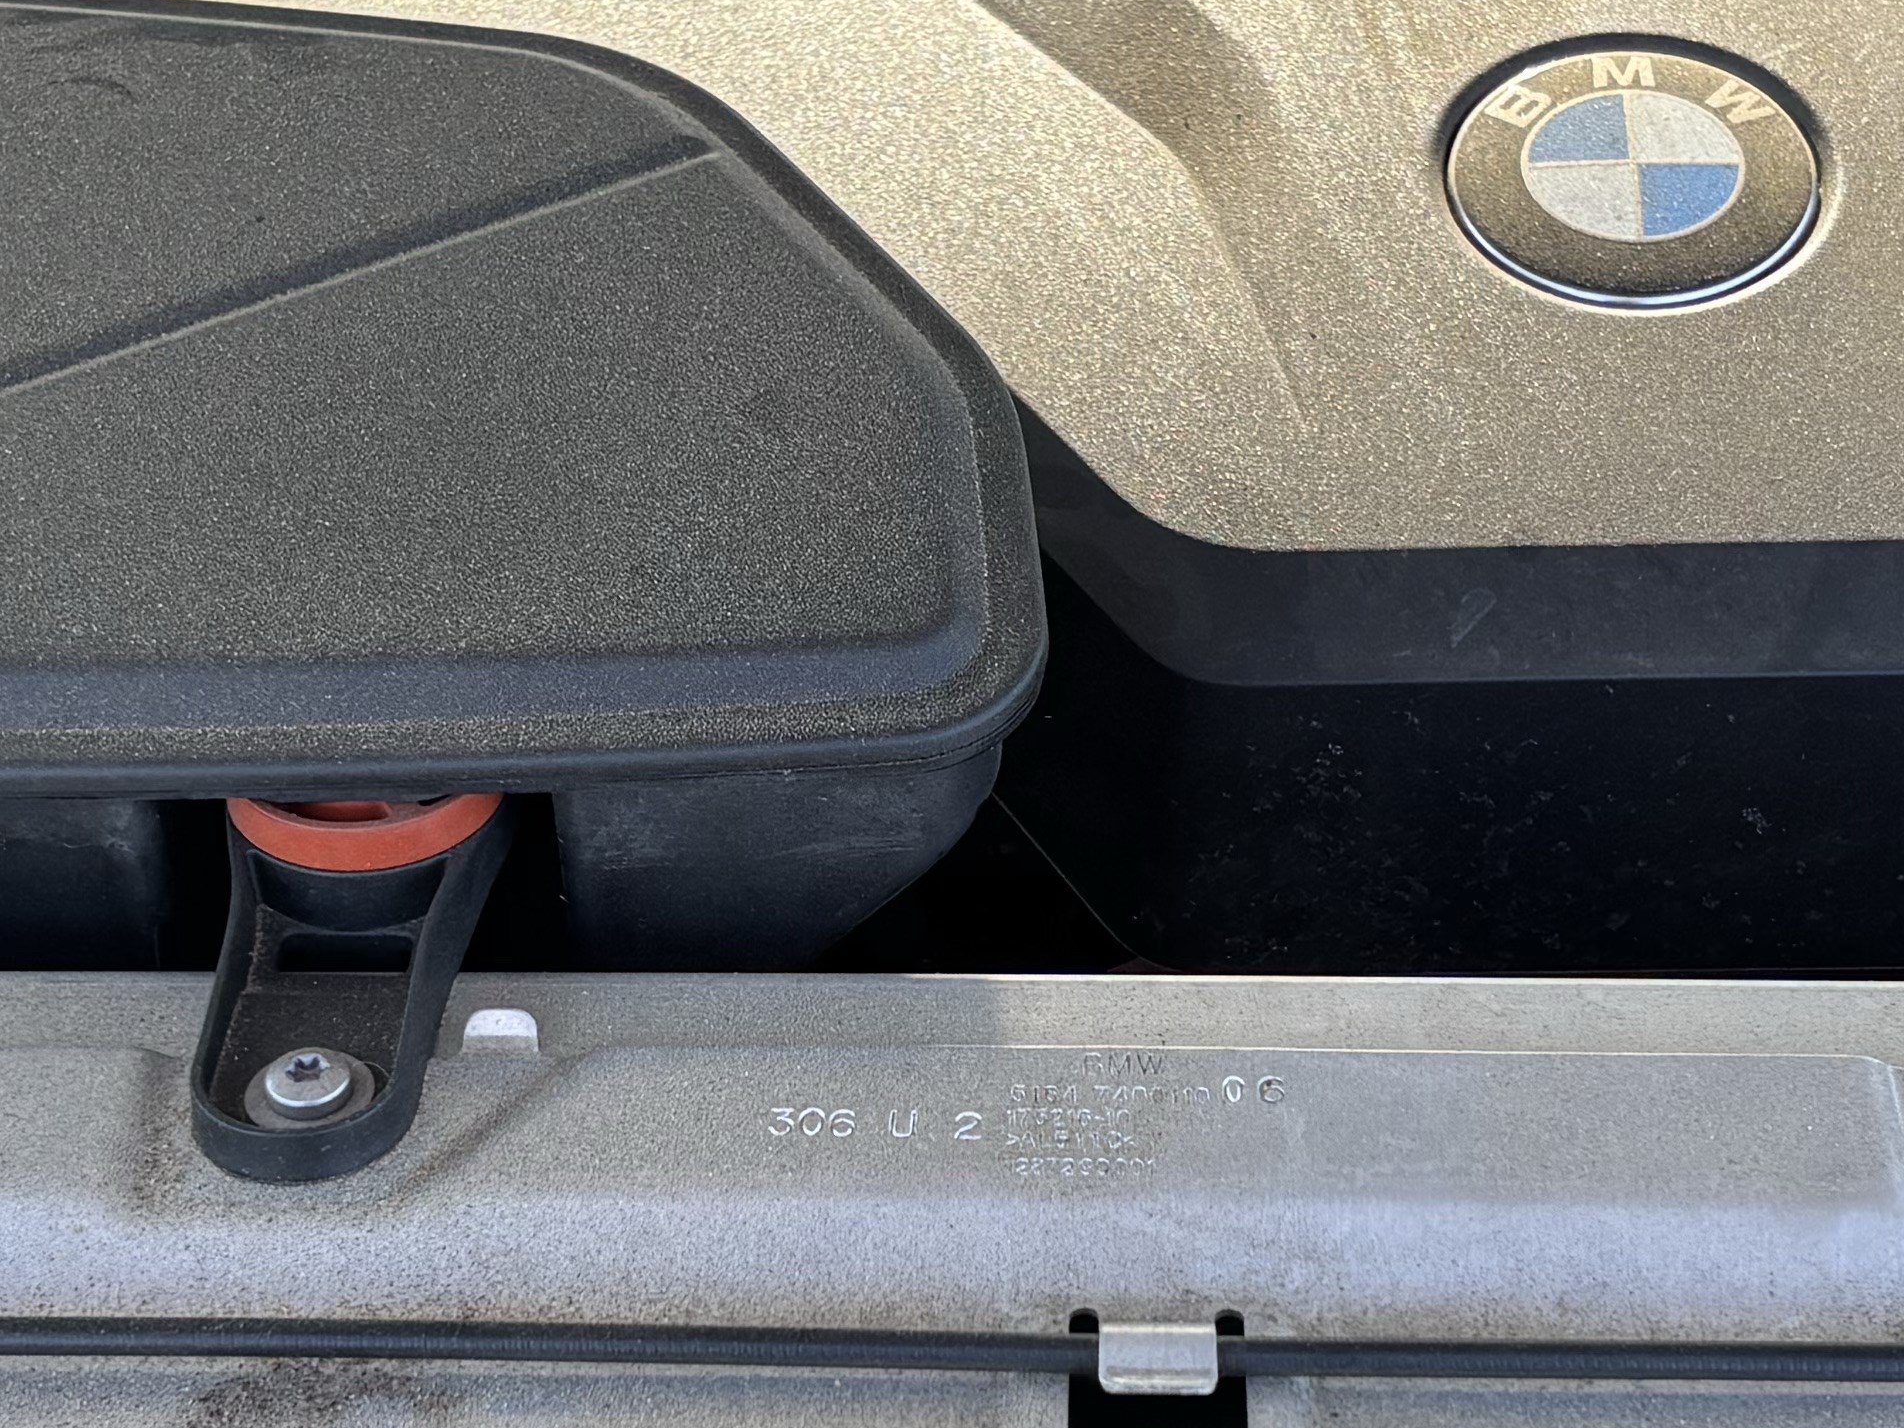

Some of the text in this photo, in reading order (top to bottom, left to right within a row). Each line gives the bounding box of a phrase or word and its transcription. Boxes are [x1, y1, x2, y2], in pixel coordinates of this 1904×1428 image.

[1484, 56, 1776, 128] BMW
[767, 1107, 984, 1140] 306 U 2
